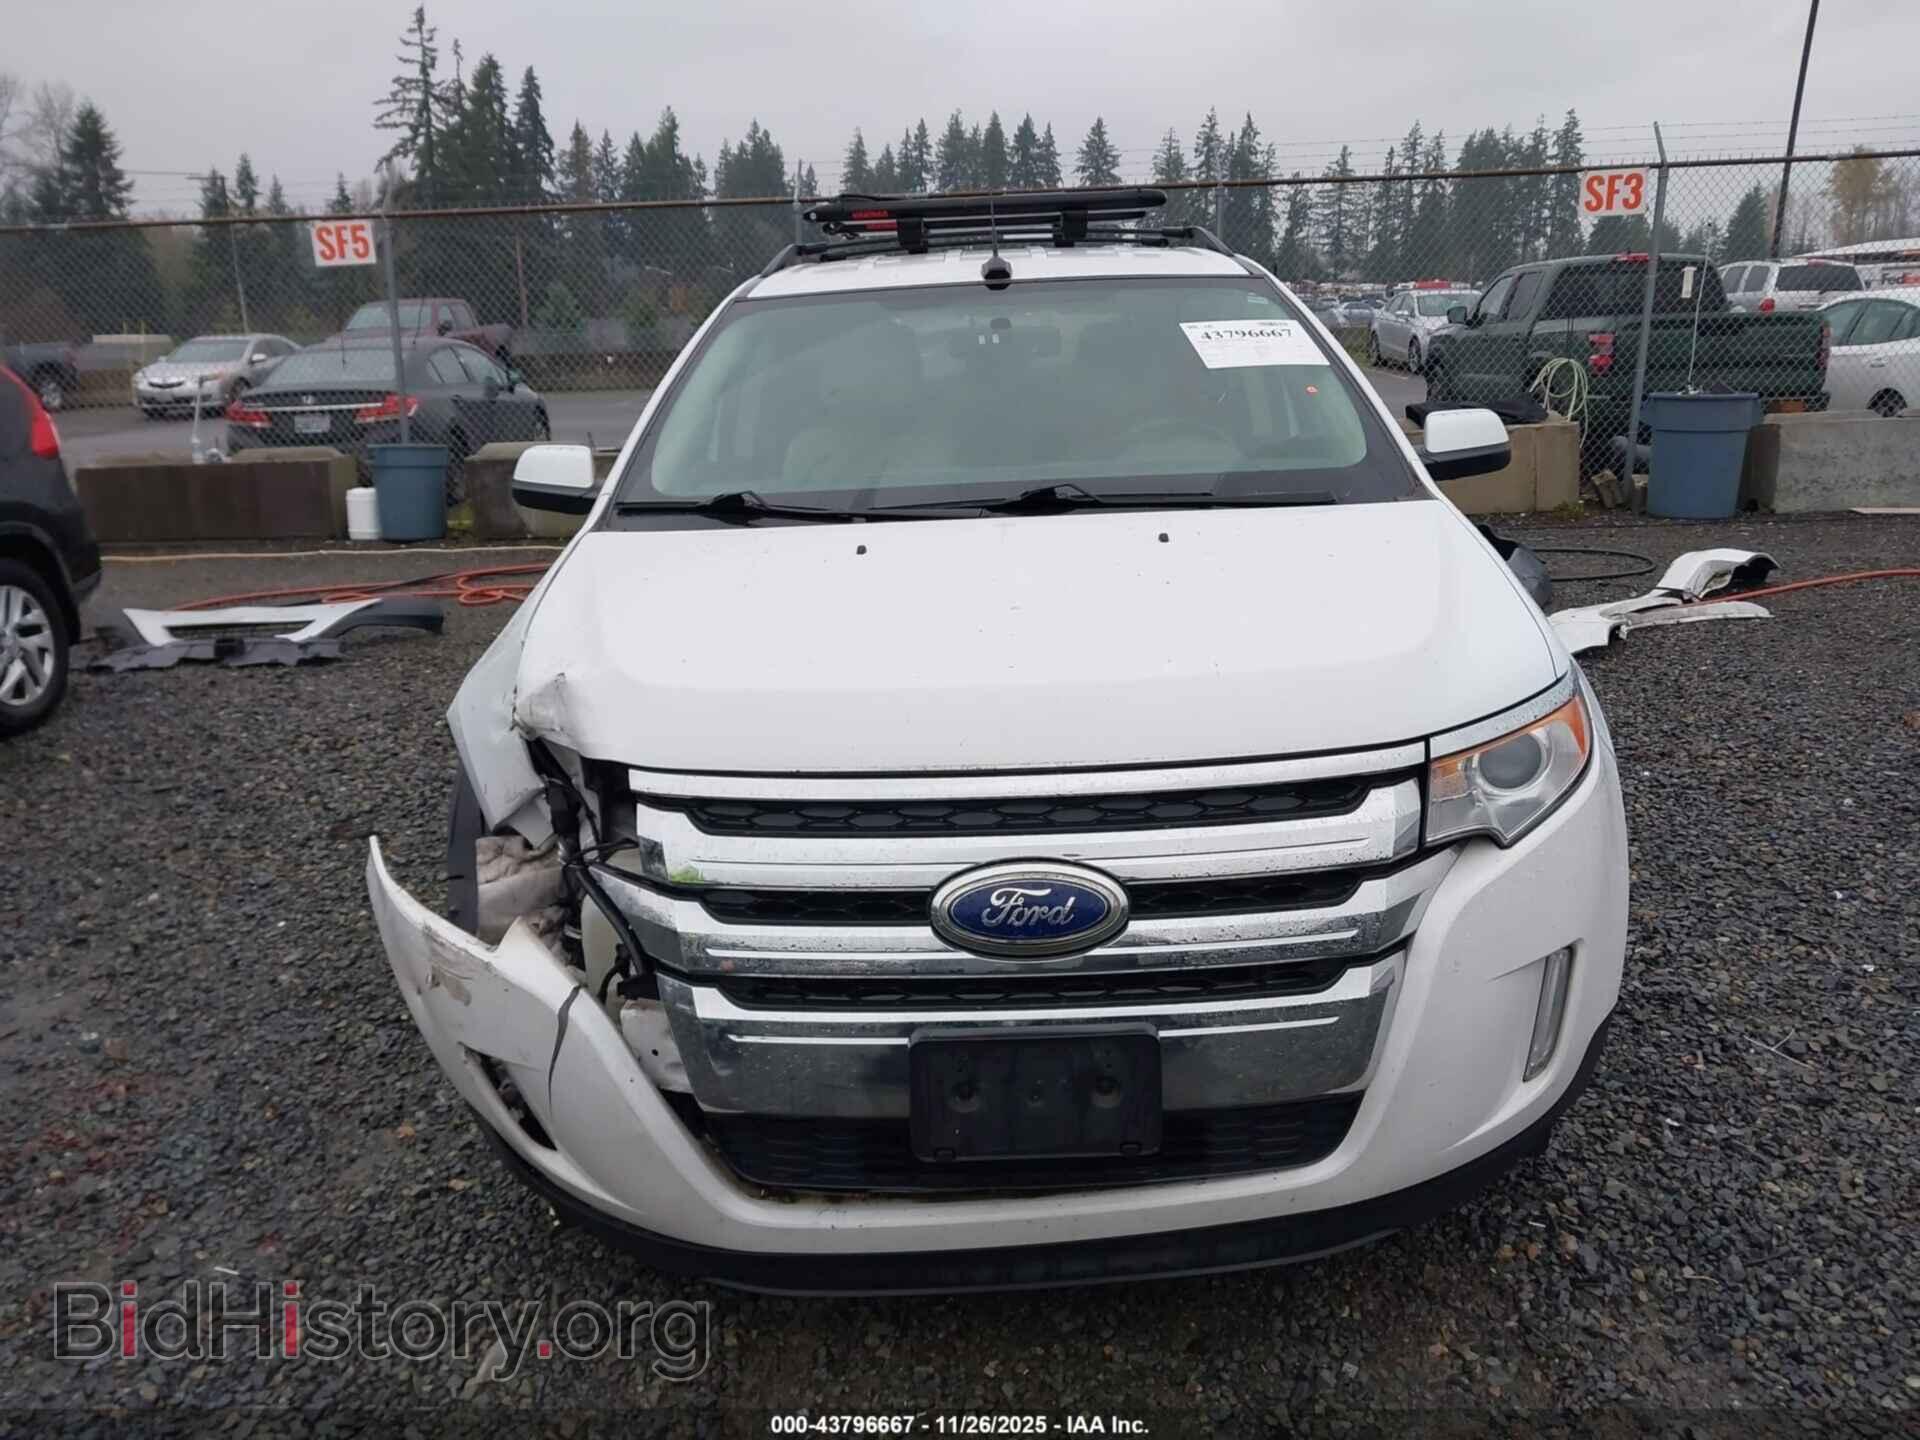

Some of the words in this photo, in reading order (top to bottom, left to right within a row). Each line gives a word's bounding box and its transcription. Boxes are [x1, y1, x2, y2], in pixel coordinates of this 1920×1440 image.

[1584, 173, 1643, 212] SF3
[316, 224, 369, 260] SF5
[1201, 328, 1293, 340] 43796667
[981, 887, 1075, 926] Ford
